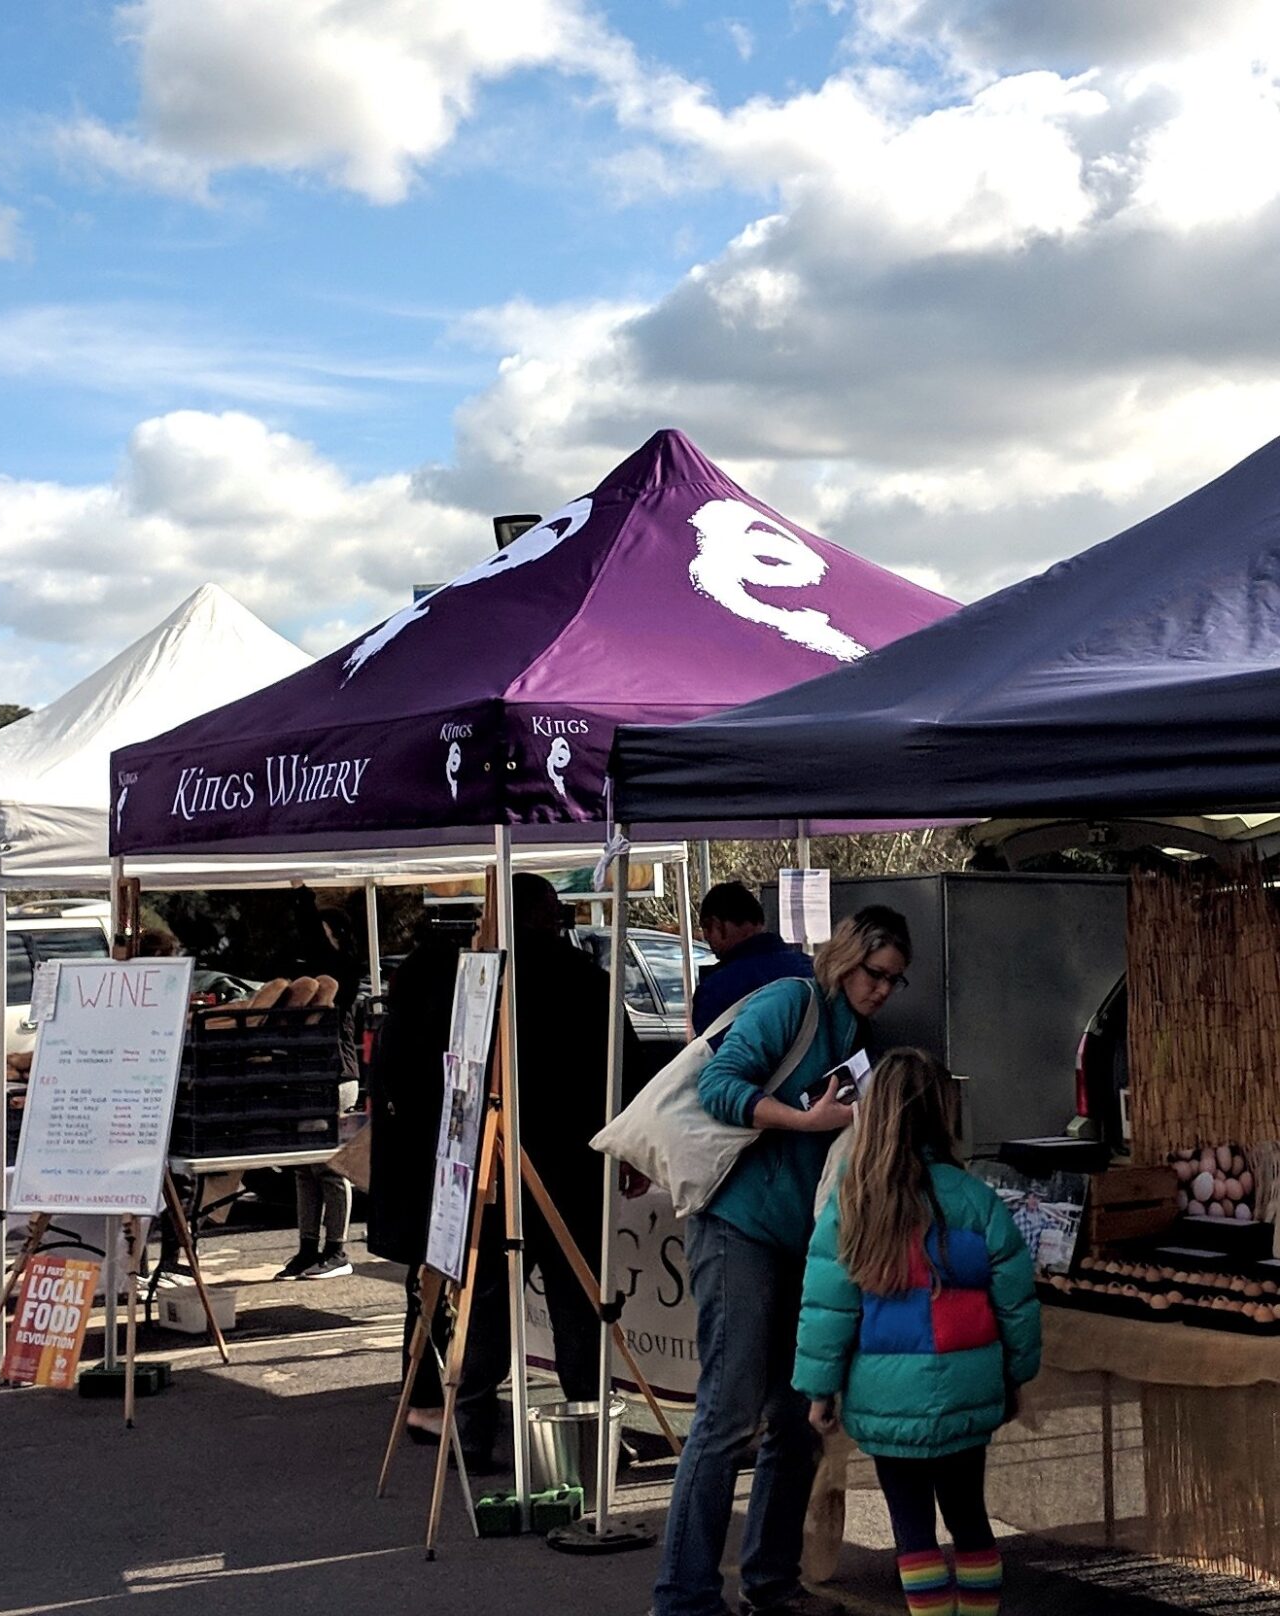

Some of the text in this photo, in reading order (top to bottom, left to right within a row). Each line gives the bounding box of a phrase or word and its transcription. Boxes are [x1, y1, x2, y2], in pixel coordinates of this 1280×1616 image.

[77, 970, 161, 1008] WINE
[46, 1266, 65, 1277] PART
[27, 1275, 85, 1305] LOCAL
[20, 1301, 81, 1334] FOOD
[16, 1330, 75, 1350] REVOLUTION
